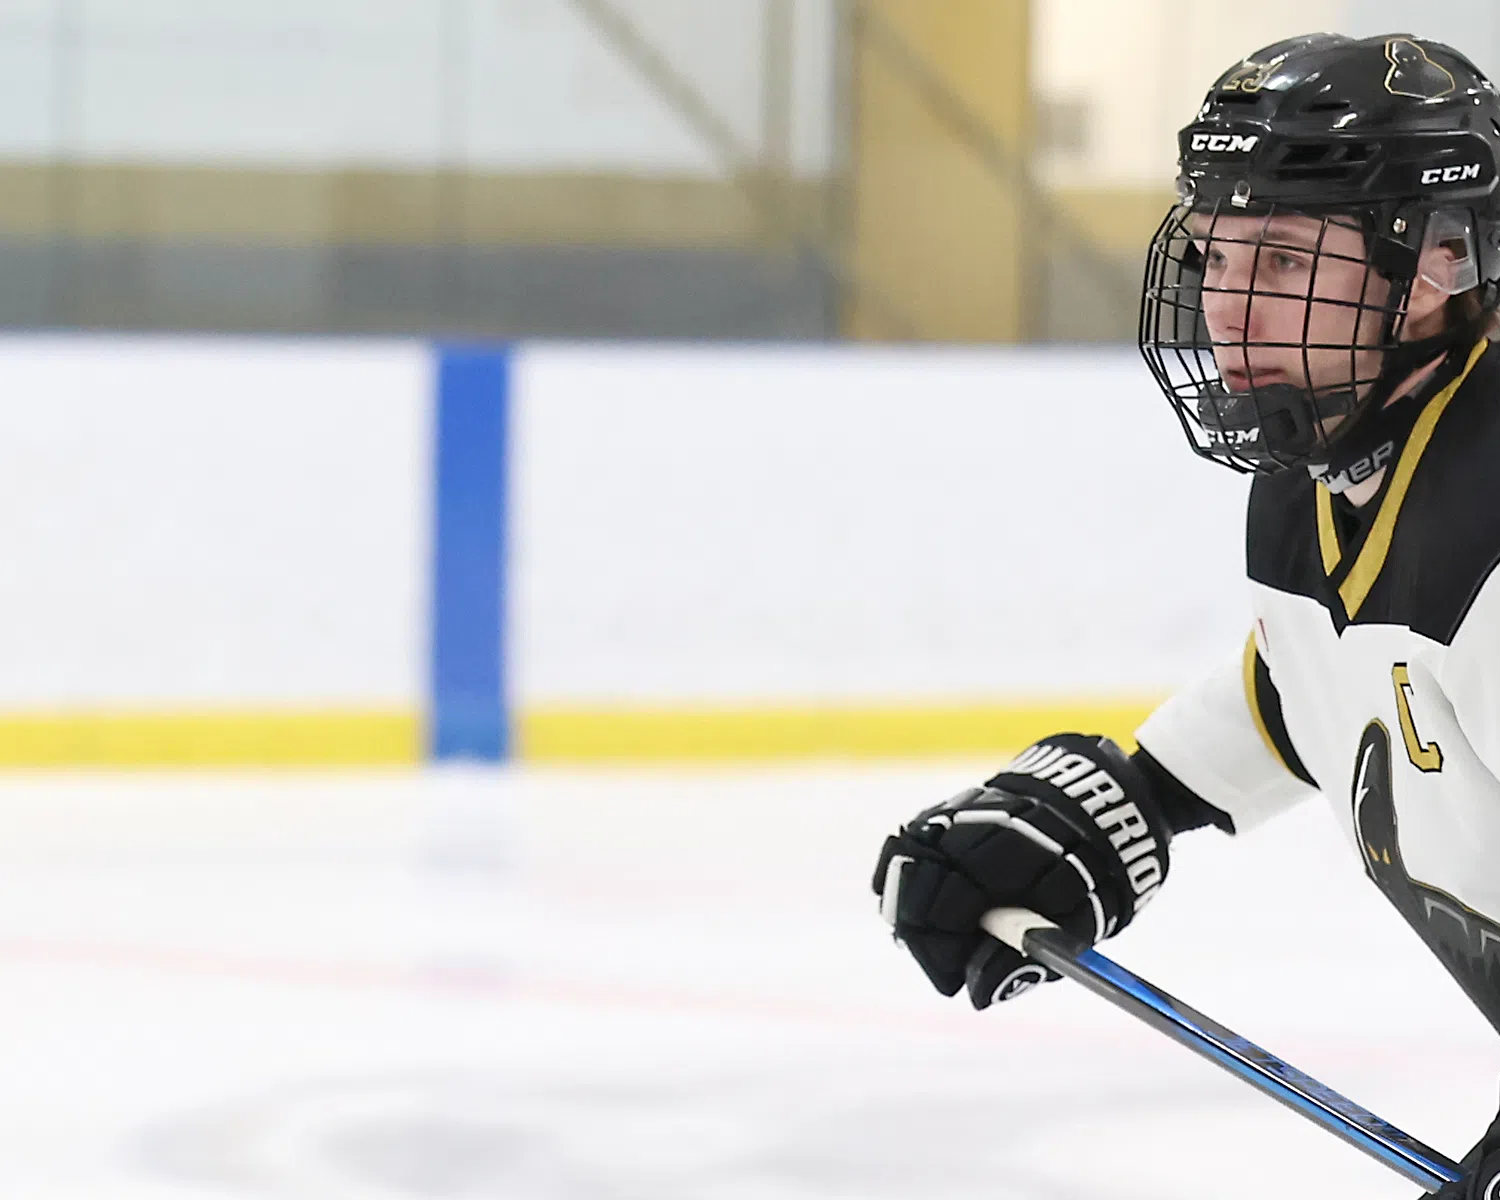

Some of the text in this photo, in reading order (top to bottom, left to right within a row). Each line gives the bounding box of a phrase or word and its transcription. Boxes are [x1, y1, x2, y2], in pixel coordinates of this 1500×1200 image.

[1190, 133, 1259, 154] CCM
[1421, 163, 1480, 185] CCM
[1391, 661, 1444, 773] C
[1006, 745, 1163, 912] WARRIO
